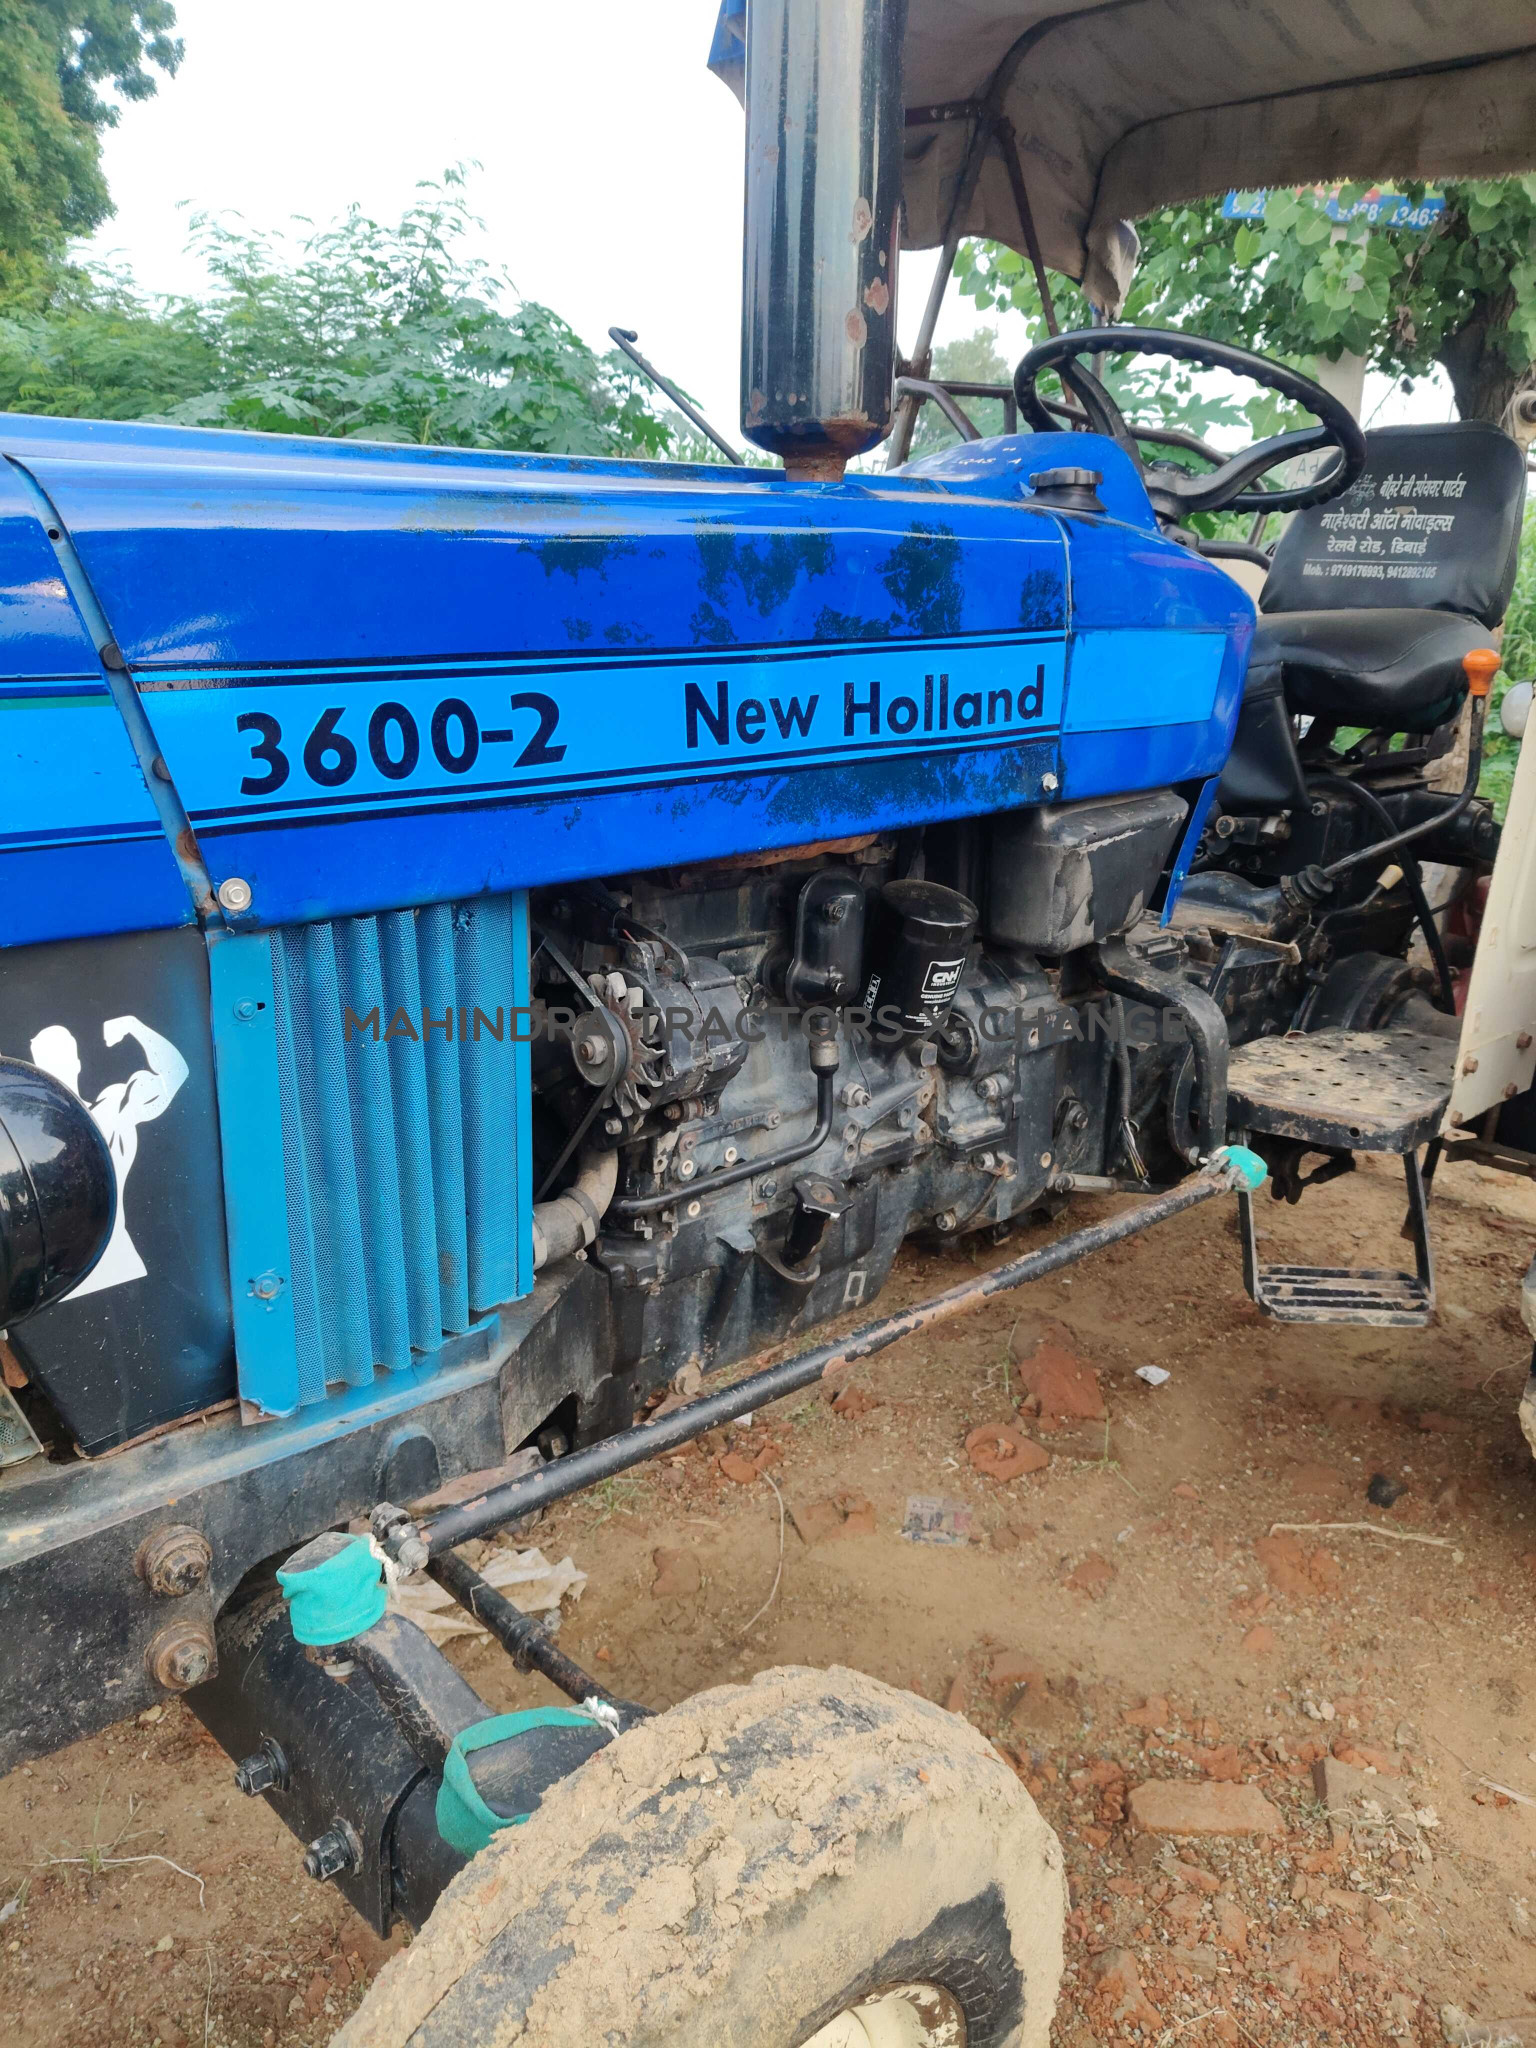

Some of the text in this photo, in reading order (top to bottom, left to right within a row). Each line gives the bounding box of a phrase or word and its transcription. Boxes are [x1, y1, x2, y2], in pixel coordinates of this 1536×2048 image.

[1327, 534, 1357, 553] रेलवे
[1360, 536, 1387, 556] रोड,
[685, 665, 1045, 749] New Holland
[237, 691, 566, 795] 3600-2
[932, 965, 960, 983] CNH
